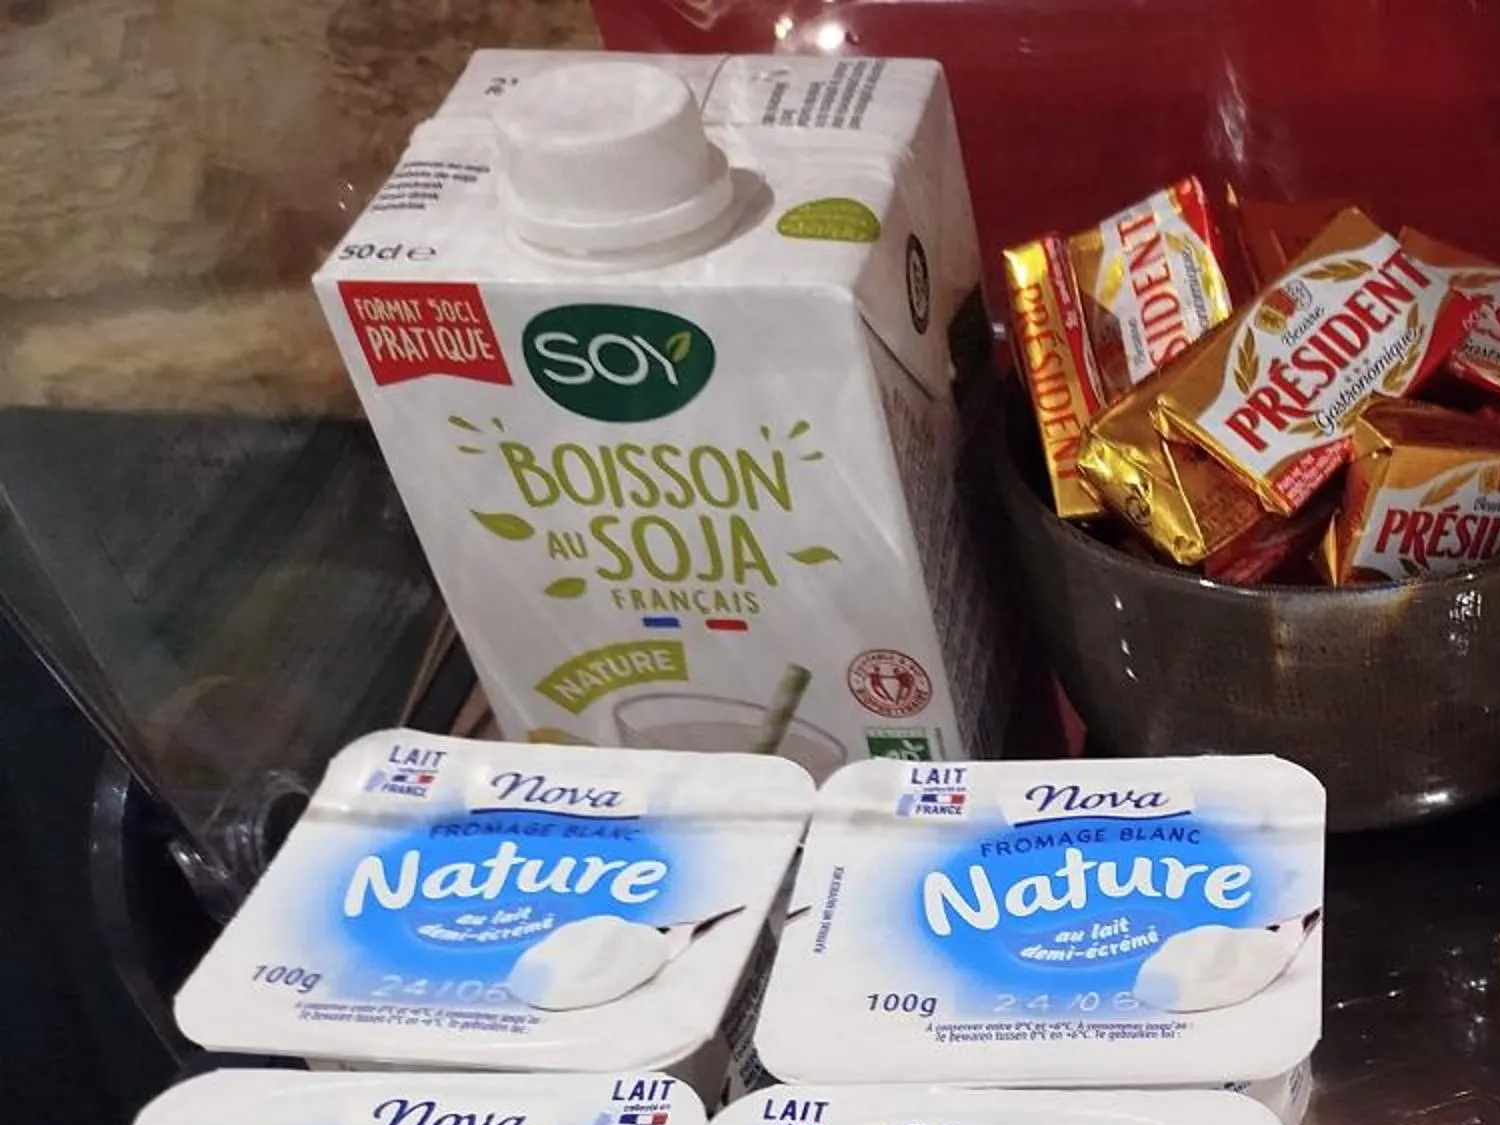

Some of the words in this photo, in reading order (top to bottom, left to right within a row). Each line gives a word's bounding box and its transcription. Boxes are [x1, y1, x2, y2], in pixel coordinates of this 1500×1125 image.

[1117, 210, 1192, 369] SIDENT
[353, 297, 422, 323] FORMAT
[364, 325, 495, 364] PRATIQUE
[534, 331, 691, 387] SOY
[1225, 251, 1432, 454] PRÉSIDENT
[499, 441, 793, 512] BOISSON
[547, 530, 588, 561] AU
[588, 515, 778, 588] SOJA
[611, 588, 761, 616] FRANÇAIS
[553, 647, 678, 703] NATURE
[388, 744, 447, 769] LAIT
[491, 771, 624, 808] Nova
[911, 767, 968, 785] LAIT
[1024, 783, 1170, 813] Nova
[429, 822, 558, 839] FROMAGE
[563, 823, 641, 841] BLANC
[980, 826, 1107, 858] FROMAGE
[1119, 825, 1201, 845] BLANC
[343, 841, 668, 917] Nature
[923, 846, 1253, 937] Nature
[1055, 929, 1086, 945] au
[1091, 916, 1131, 942] lait
[252, 964, 323, 994] 100g
[866, 993, 938, 1018] 100g
[611, 1079, 677, 1101] LAIT
[763, 1098, 831, 1123] LAIT
